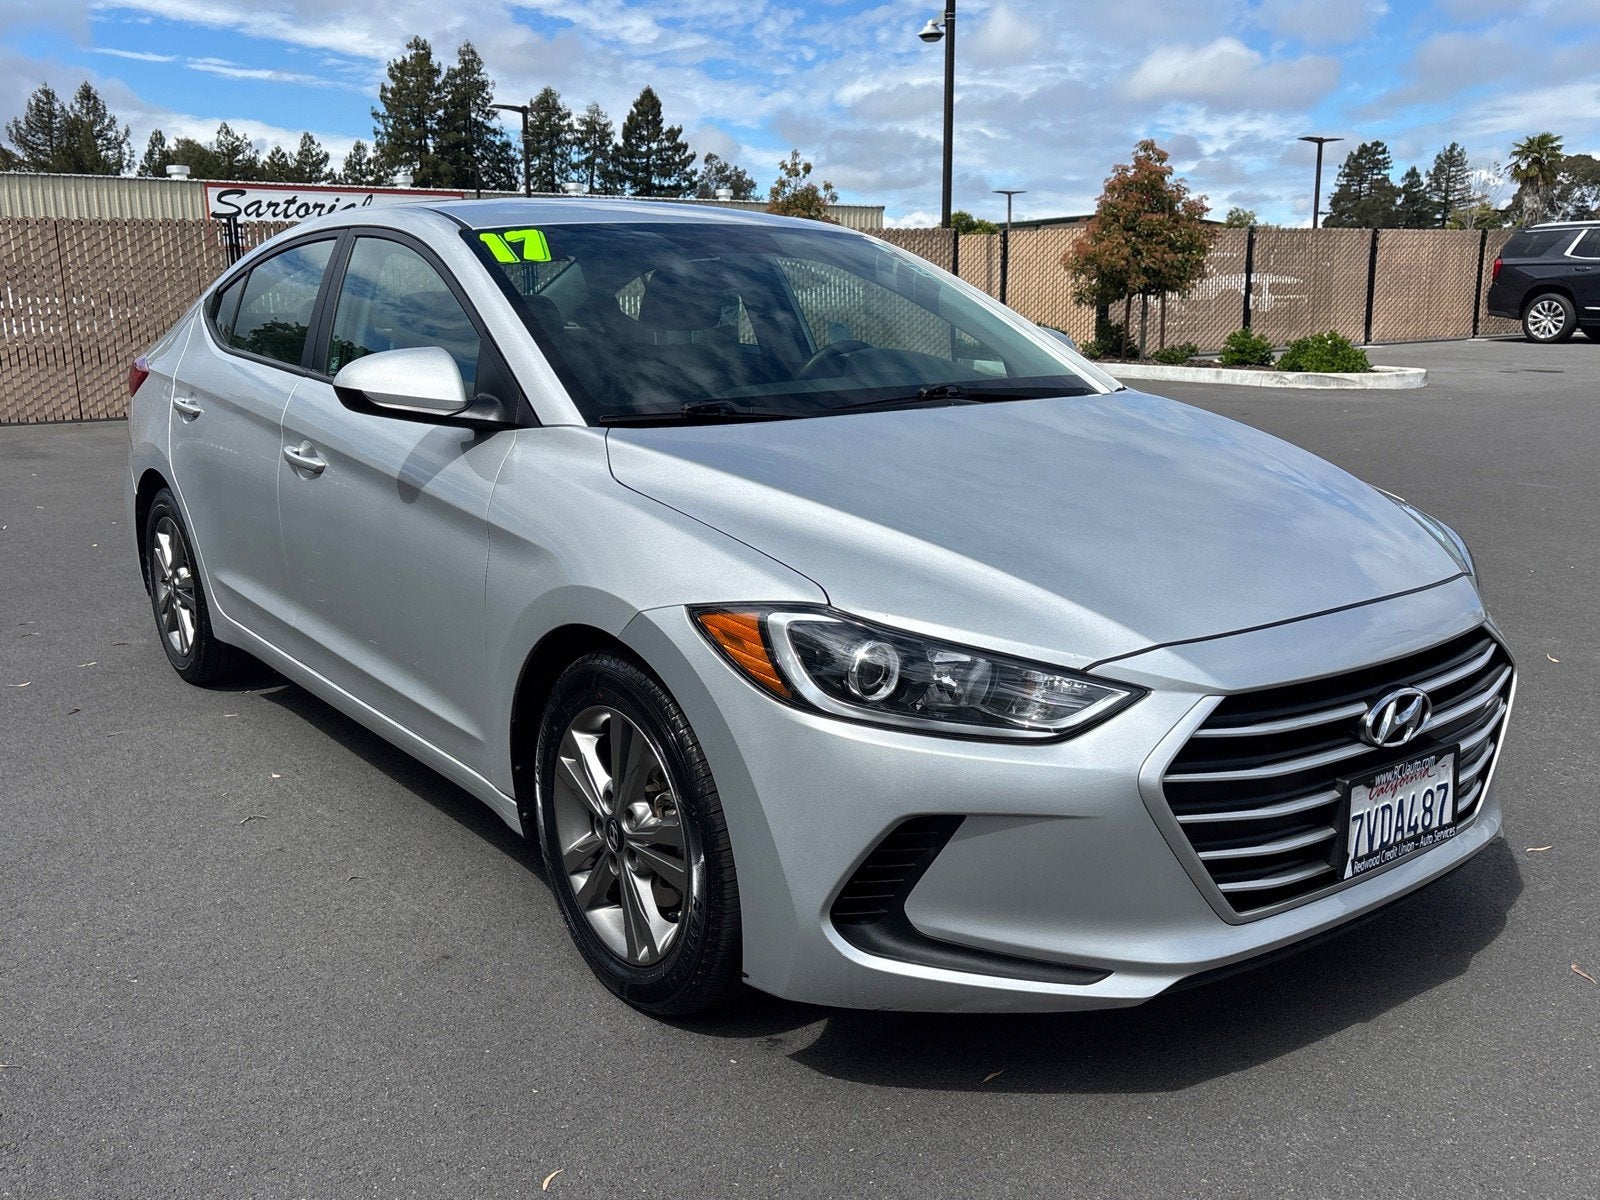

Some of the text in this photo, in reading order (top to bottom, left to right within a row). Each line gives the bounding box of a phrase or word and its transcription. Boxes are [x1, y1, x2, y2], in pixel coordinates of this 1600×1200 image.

[479, 229, 552, 263] 17
[1352, 782, 1449, 858] 7VDA487
[1353, 852, 1380, 874] Redwood
[1381, 846, 1397, 862] Credit
[1398, 841, 1415, 856] Union
[1419, 835, 1432, 847] Auto
[1433, 826, 1456, 841] Services
